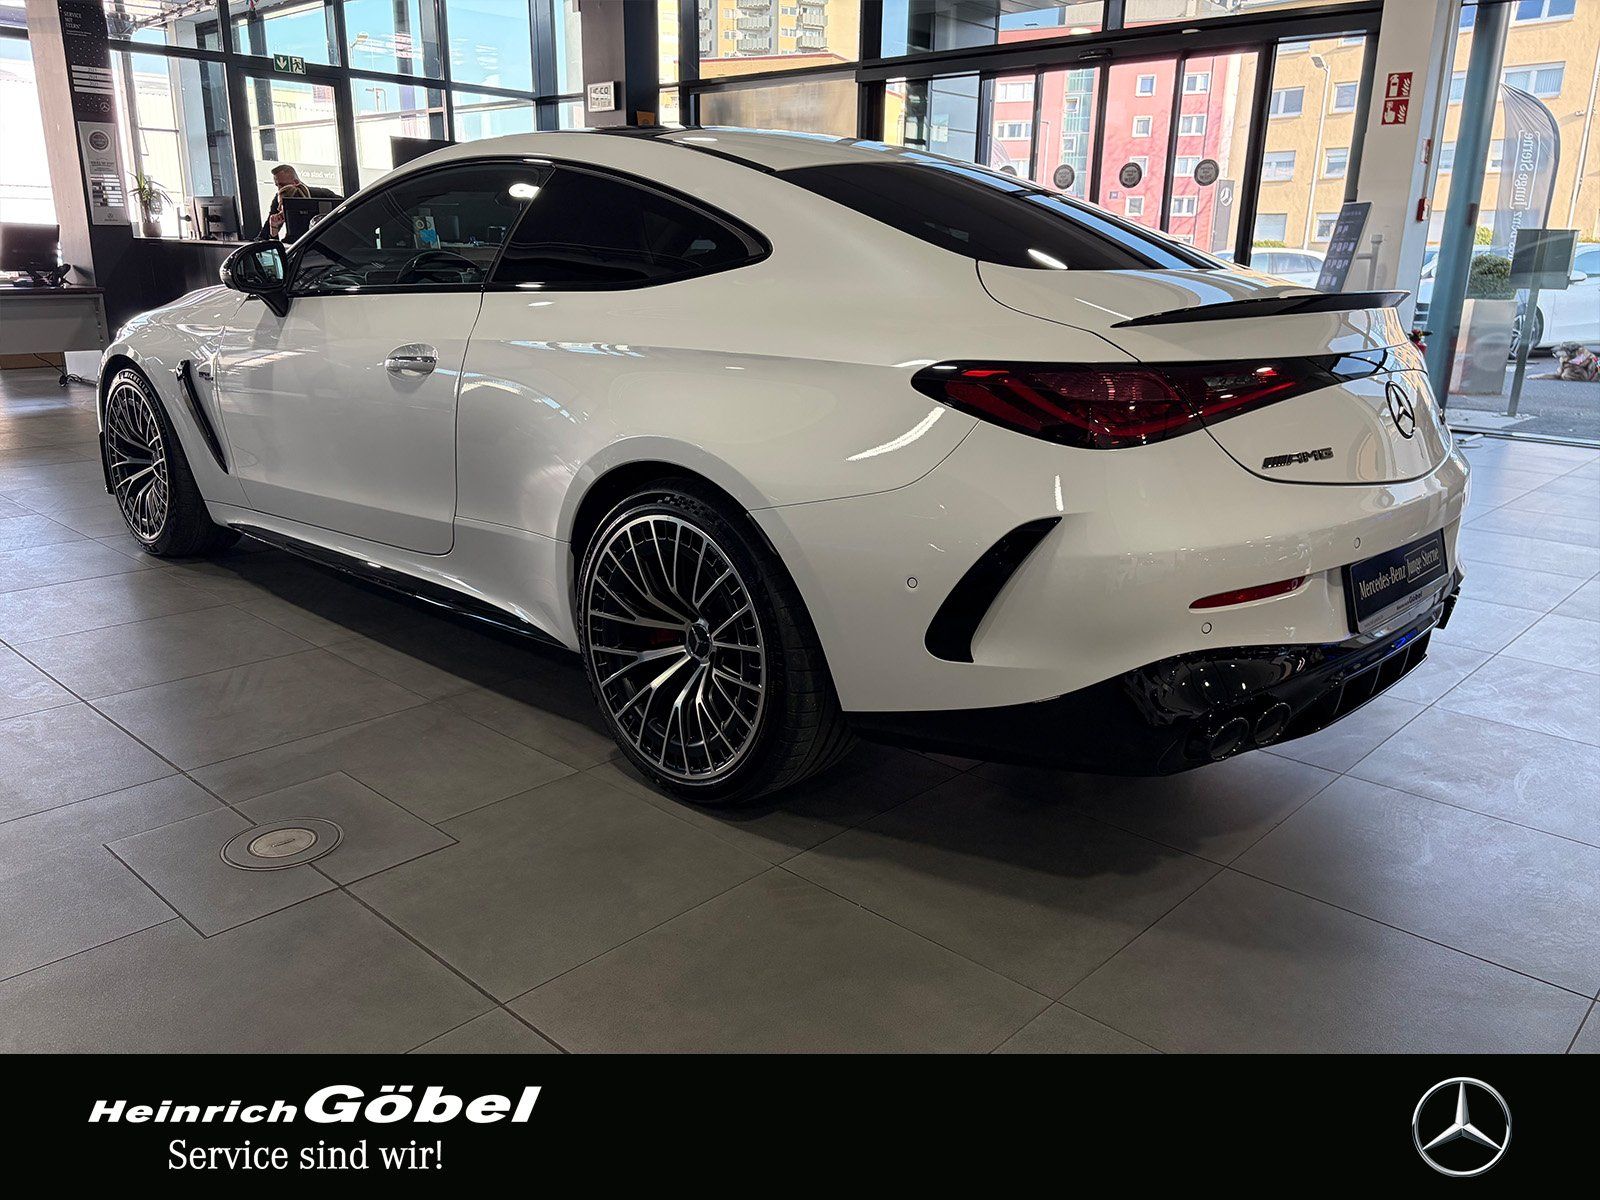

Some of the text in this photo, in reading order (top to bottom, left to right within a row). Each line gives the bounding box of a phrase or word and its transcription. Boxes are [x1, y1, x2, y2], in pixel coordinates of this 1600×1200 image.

[125, 372, 149, 394] MICHELIN
[1284, 447, 1334, 466] AMG
[1359, 548, 1439, 600] Mercedes-Benz Junge Sterne
